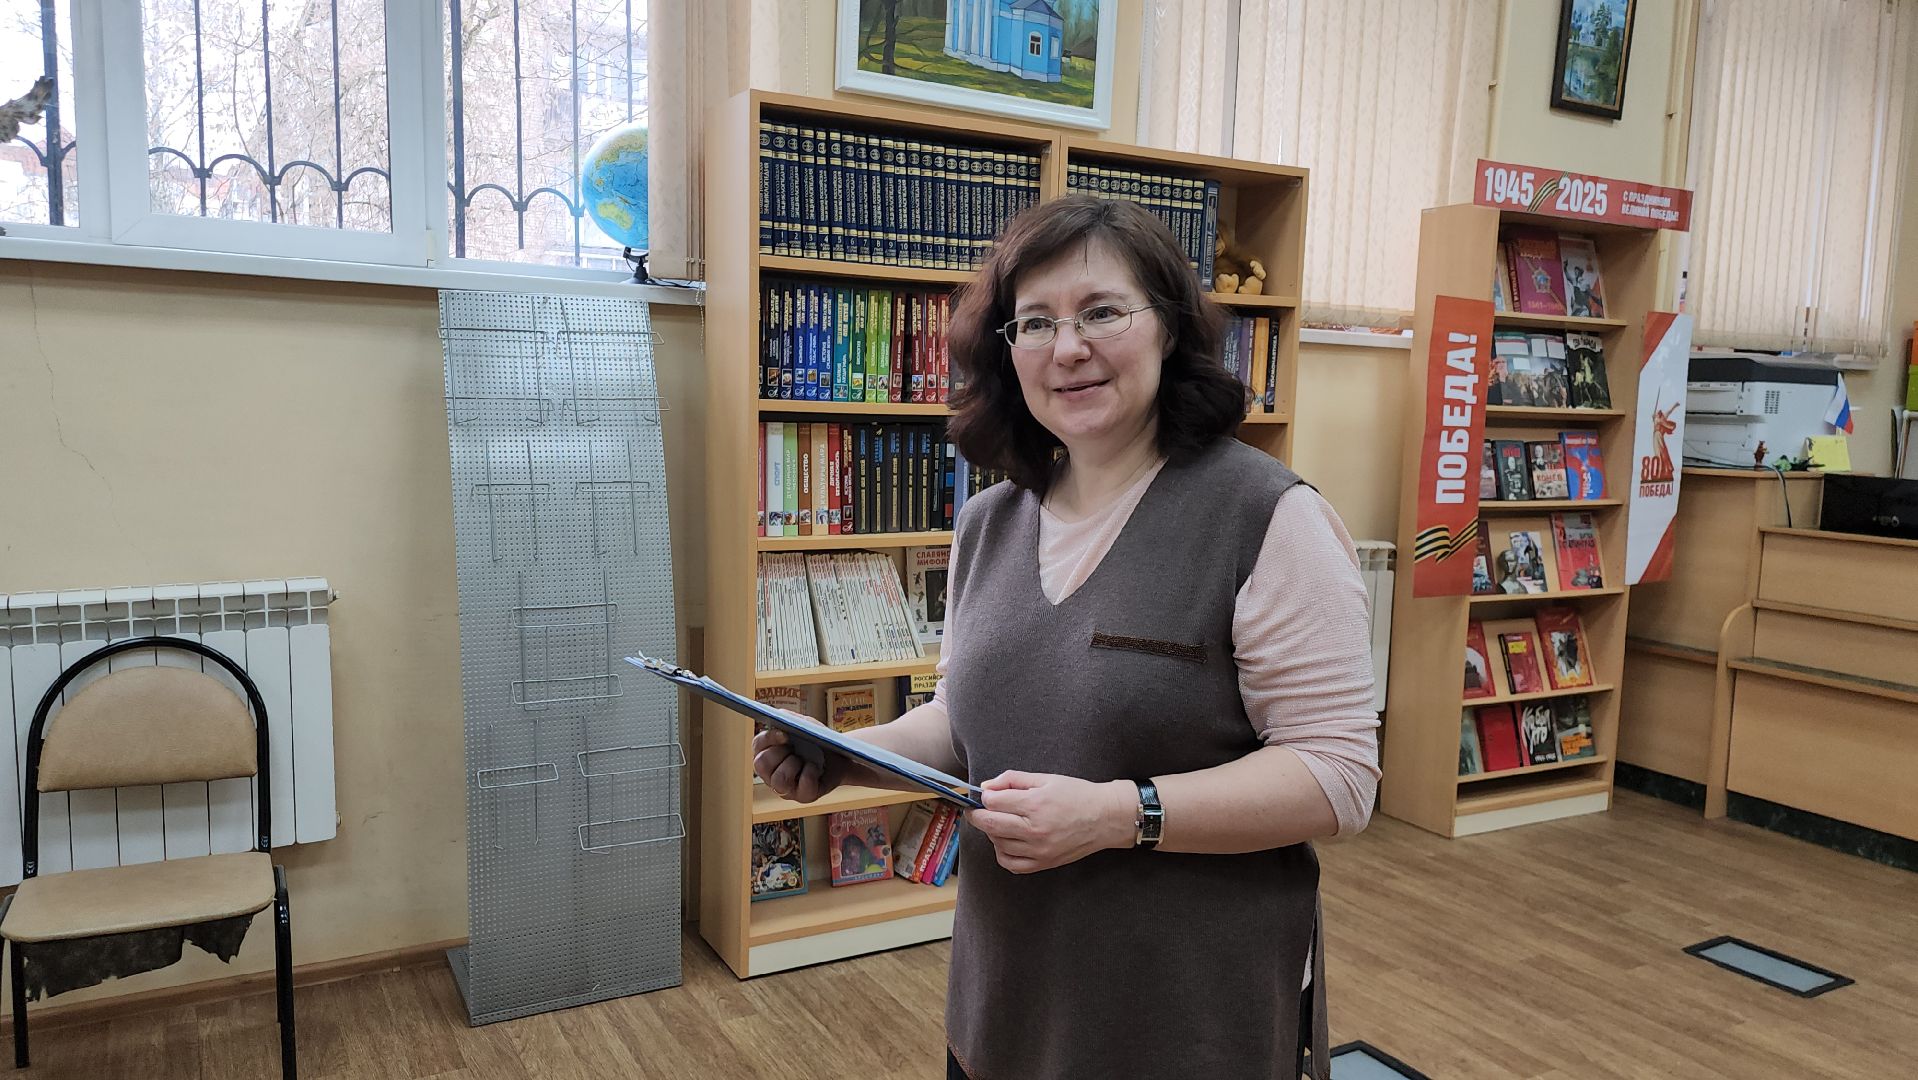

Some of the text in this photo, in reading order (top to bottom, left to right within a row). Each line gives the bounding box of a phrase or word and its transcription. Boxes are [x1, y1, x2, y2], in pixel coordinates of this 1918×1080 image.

[1485, 167, 1608, 216] 1945 2025
[1623, 190, 1628, 201] С
[781, 231, 783, 242] 1
[825, 235, 828, 243] 4
[1436, 332, 1478, 504] ПОБЕДА!
[1640, 456, 1660, 480] 80
[1639, 482, 1673, 498] ПОБЕДА!
[920, 816, 946, 872] ПРАЗДНИКИ
